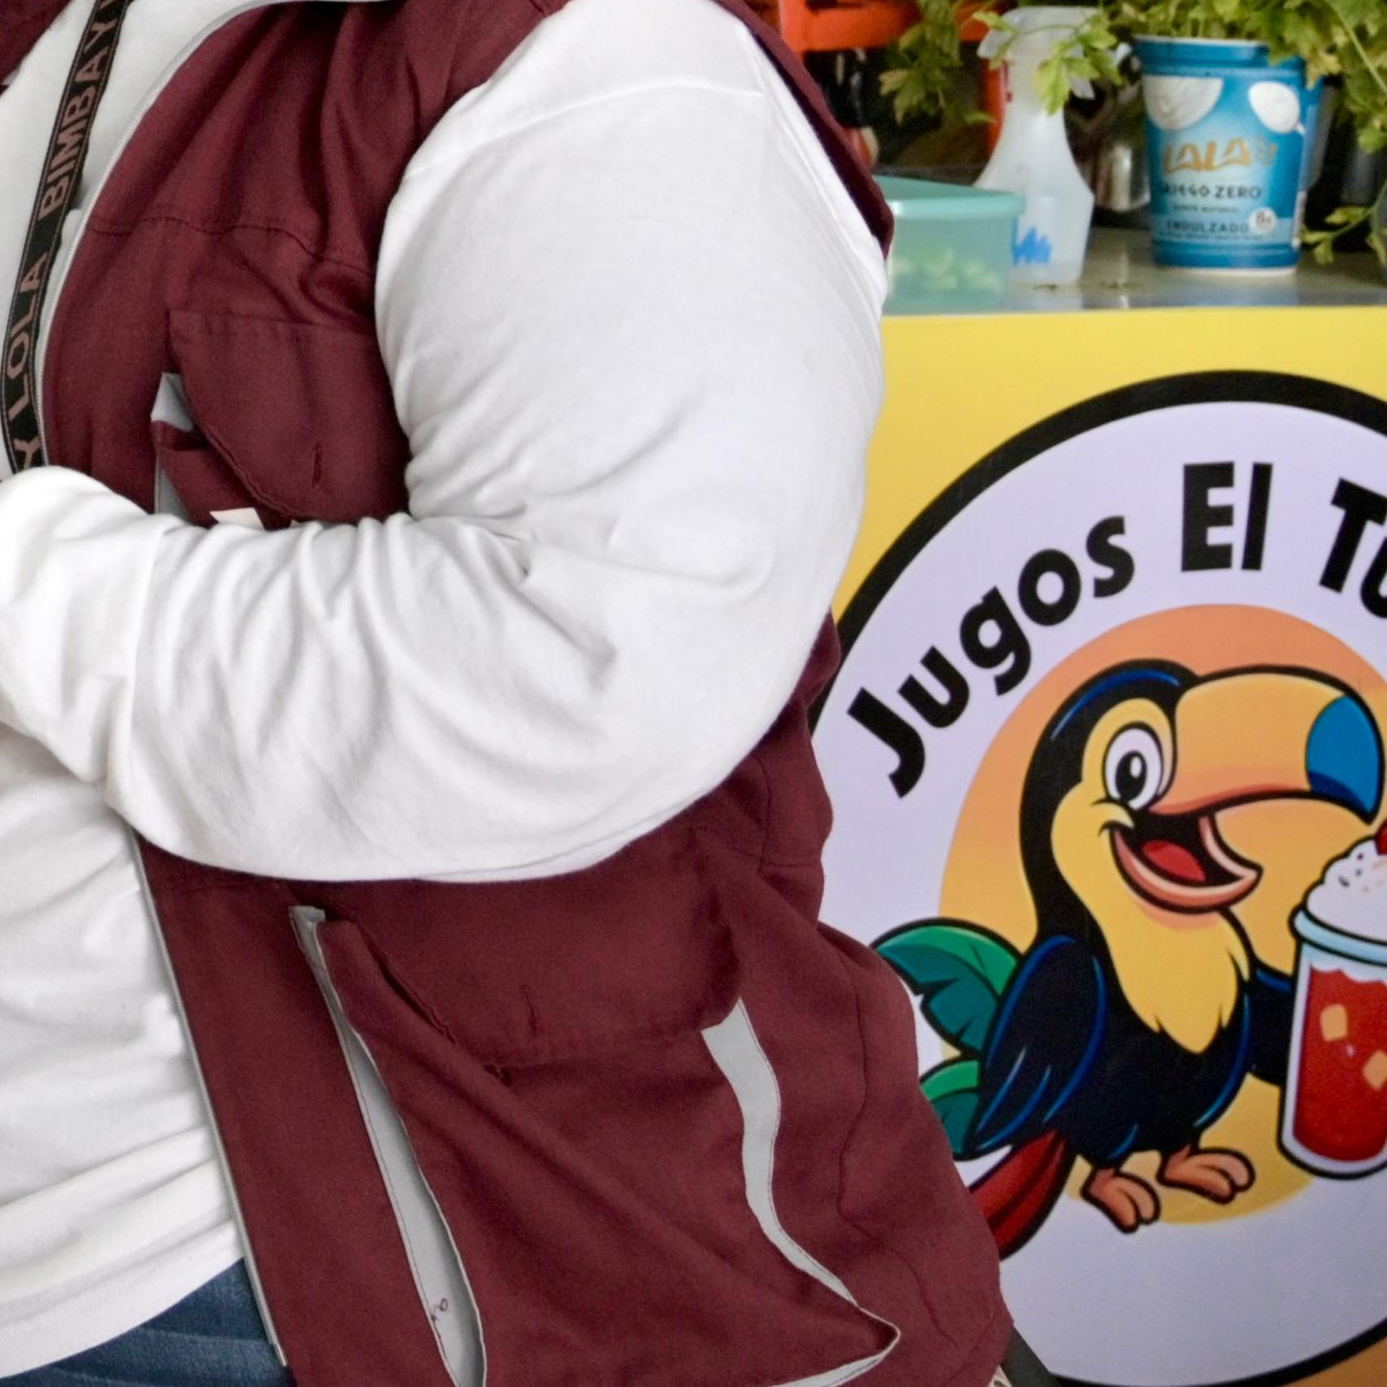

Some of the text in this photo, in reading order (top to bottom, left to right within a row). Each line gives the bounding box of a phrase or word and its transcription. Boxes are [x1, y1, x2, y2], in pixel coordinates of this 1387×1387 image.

[6, 251, 50, 421] LOLA
[37, 45, 110, 221] BIMBA
[83, 18, 119, 54] Y
[1162, 136, 1252, 175] LALA
[1214, 184, 1261, 199] ZERO
[846, 515, 1136, 800] Jugos
[1180, 460, 1274, 573] El
